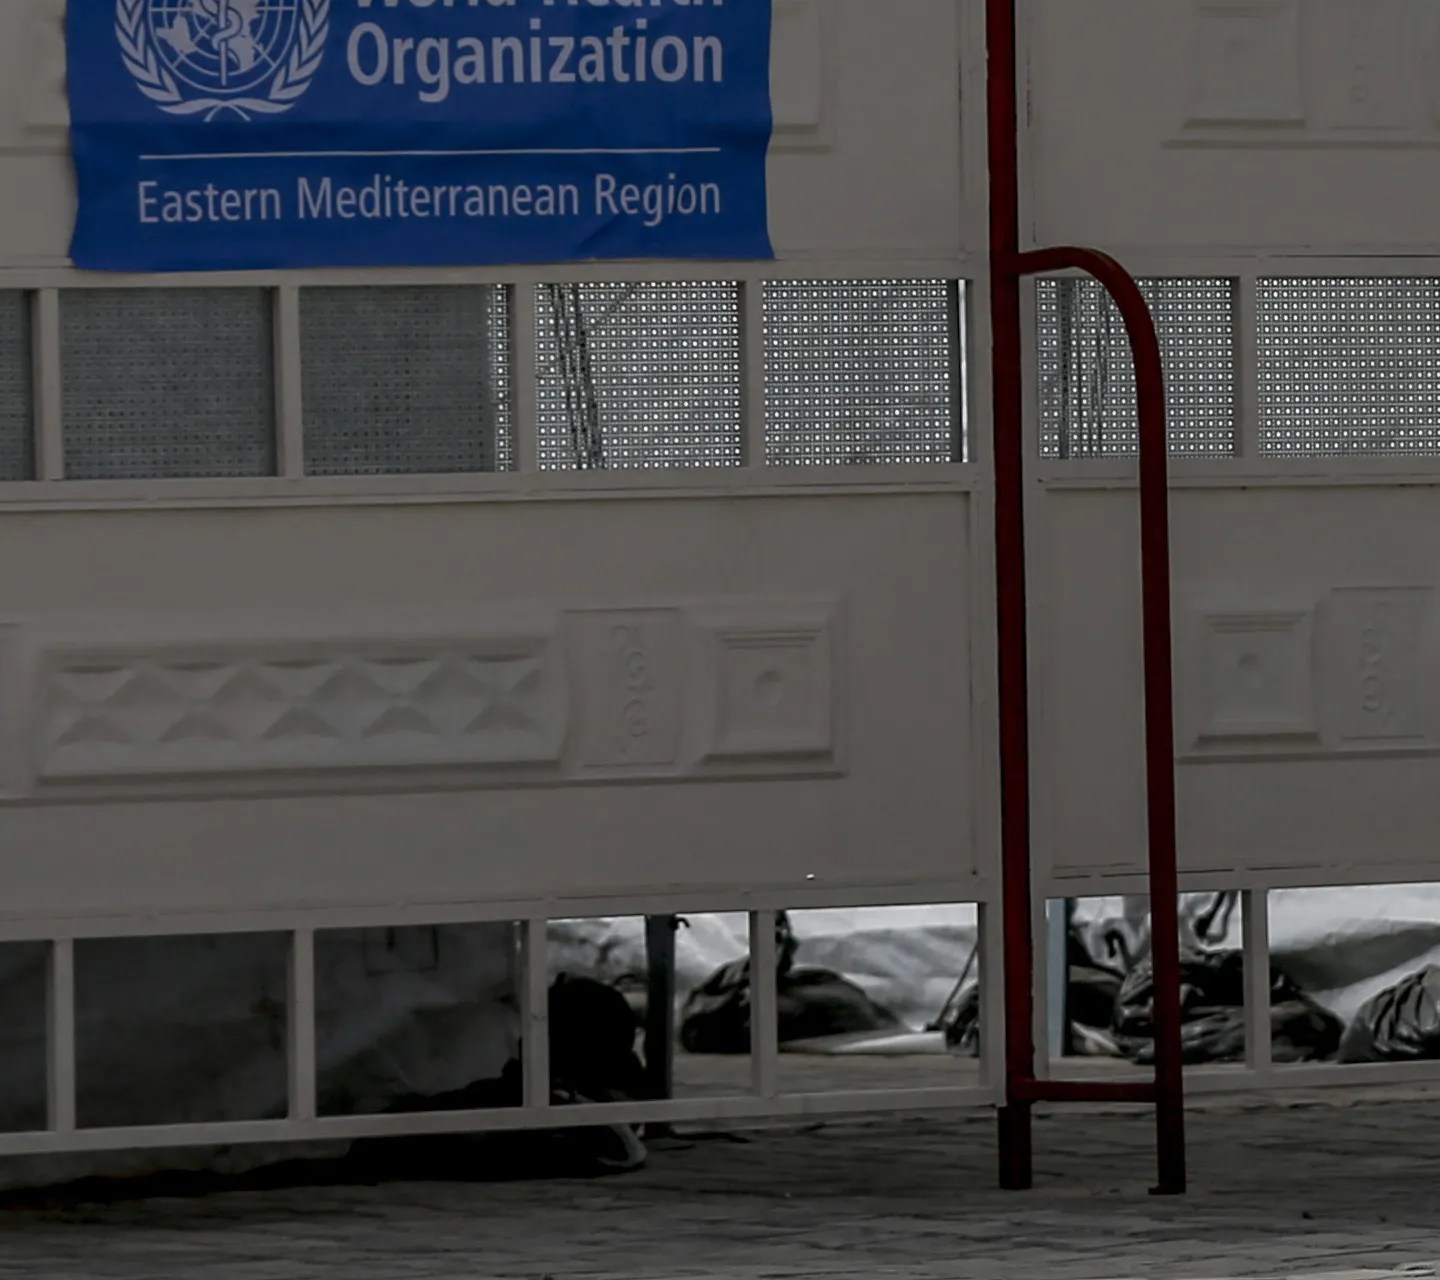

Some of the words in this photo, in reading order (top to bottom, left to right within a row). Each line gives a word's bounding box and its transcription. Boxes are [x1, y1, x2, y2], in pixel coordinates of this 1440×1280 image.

[346, 18, 723, 103] Organization
[138, 179, 281, 223] Eastern
[297, 173, 579, 219] Mediterranean
[595, 172, 721, 227] Region
